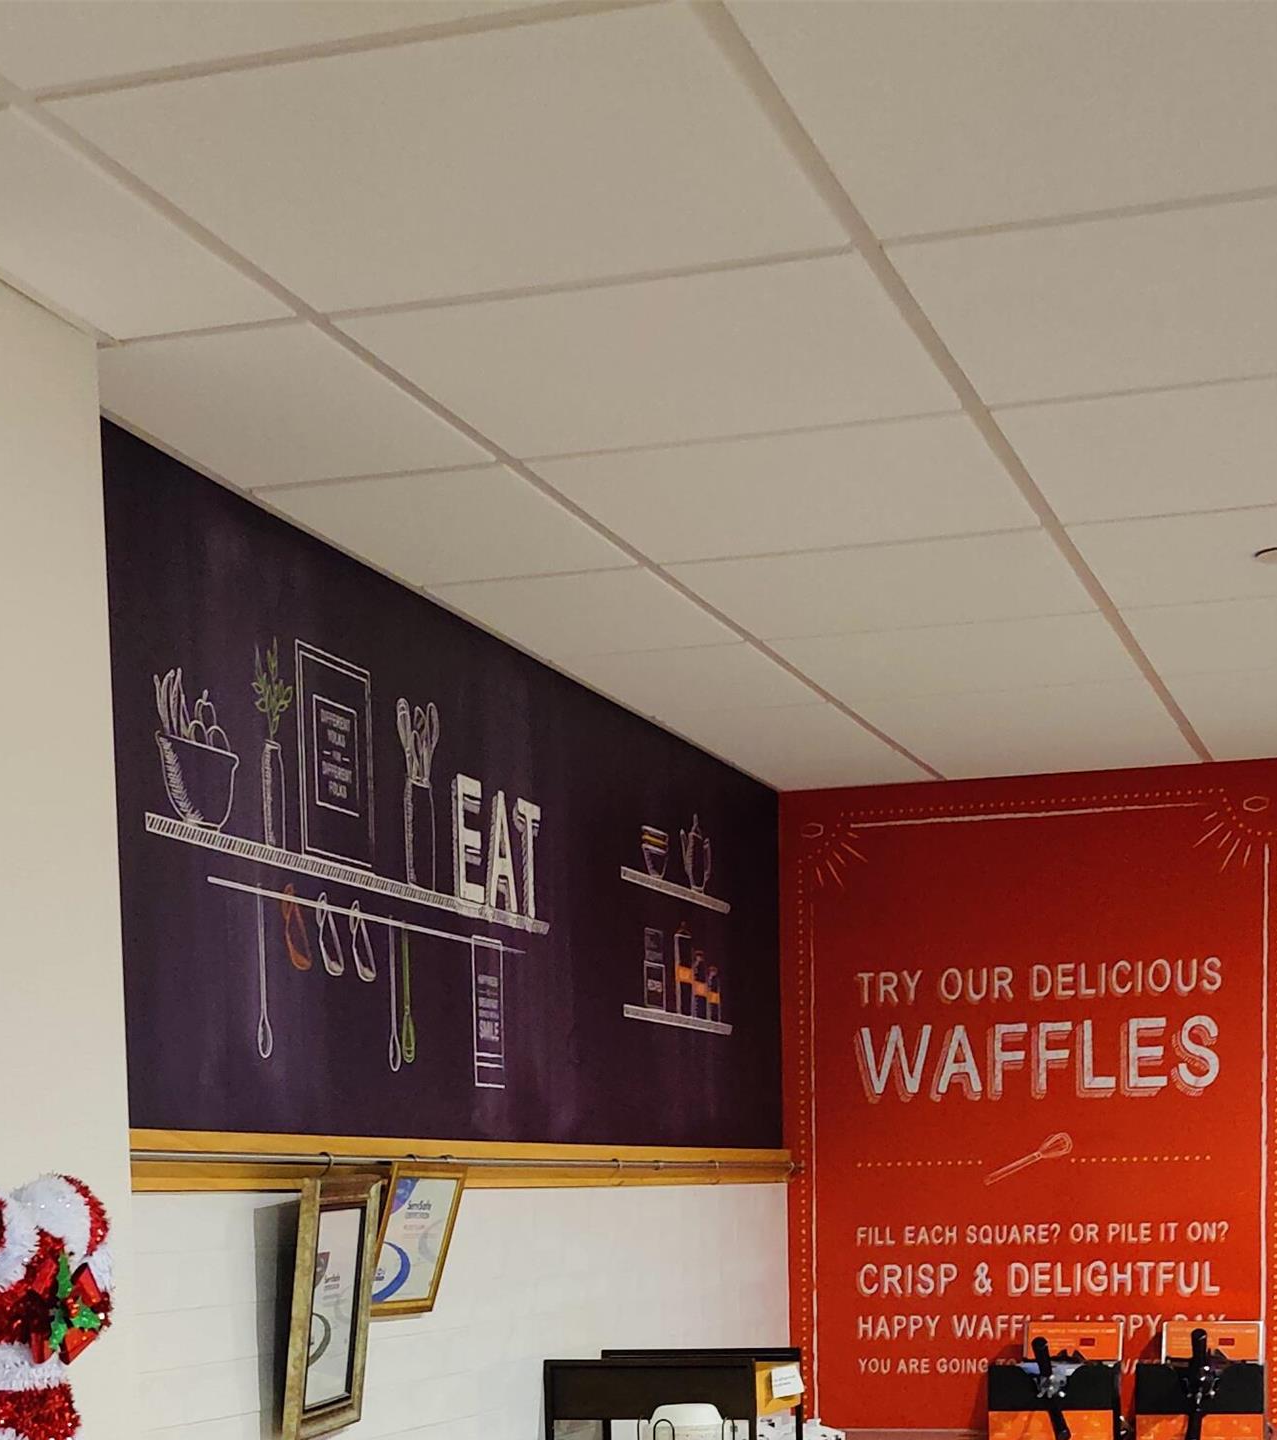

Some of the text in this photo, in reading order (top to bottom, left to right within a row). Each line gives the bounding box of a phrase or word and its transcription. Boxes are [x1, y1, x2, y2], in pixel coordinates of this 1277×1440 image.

[451, 773, 541, 918] EAT
[854, 956, 1222, 1006] TRY OUR DELICIOUS
[853, 1015, 1220, 1103] WAFFLES
[856, 1221, 1230, 1247] FILL EACH SQUARE? OR PILE IT ON?
[856, 1260, 1221, 1297] CRISP & DELIGHTFUL
[857, 1314, 940, 1340] HAPPY
[952, 1314, 1055, 1340] WAFF
[858, 1358, 891, 1374] YOU
[896, 1358, 930, 1375] ARE
[936, 1358, 989, 1374] GOING
